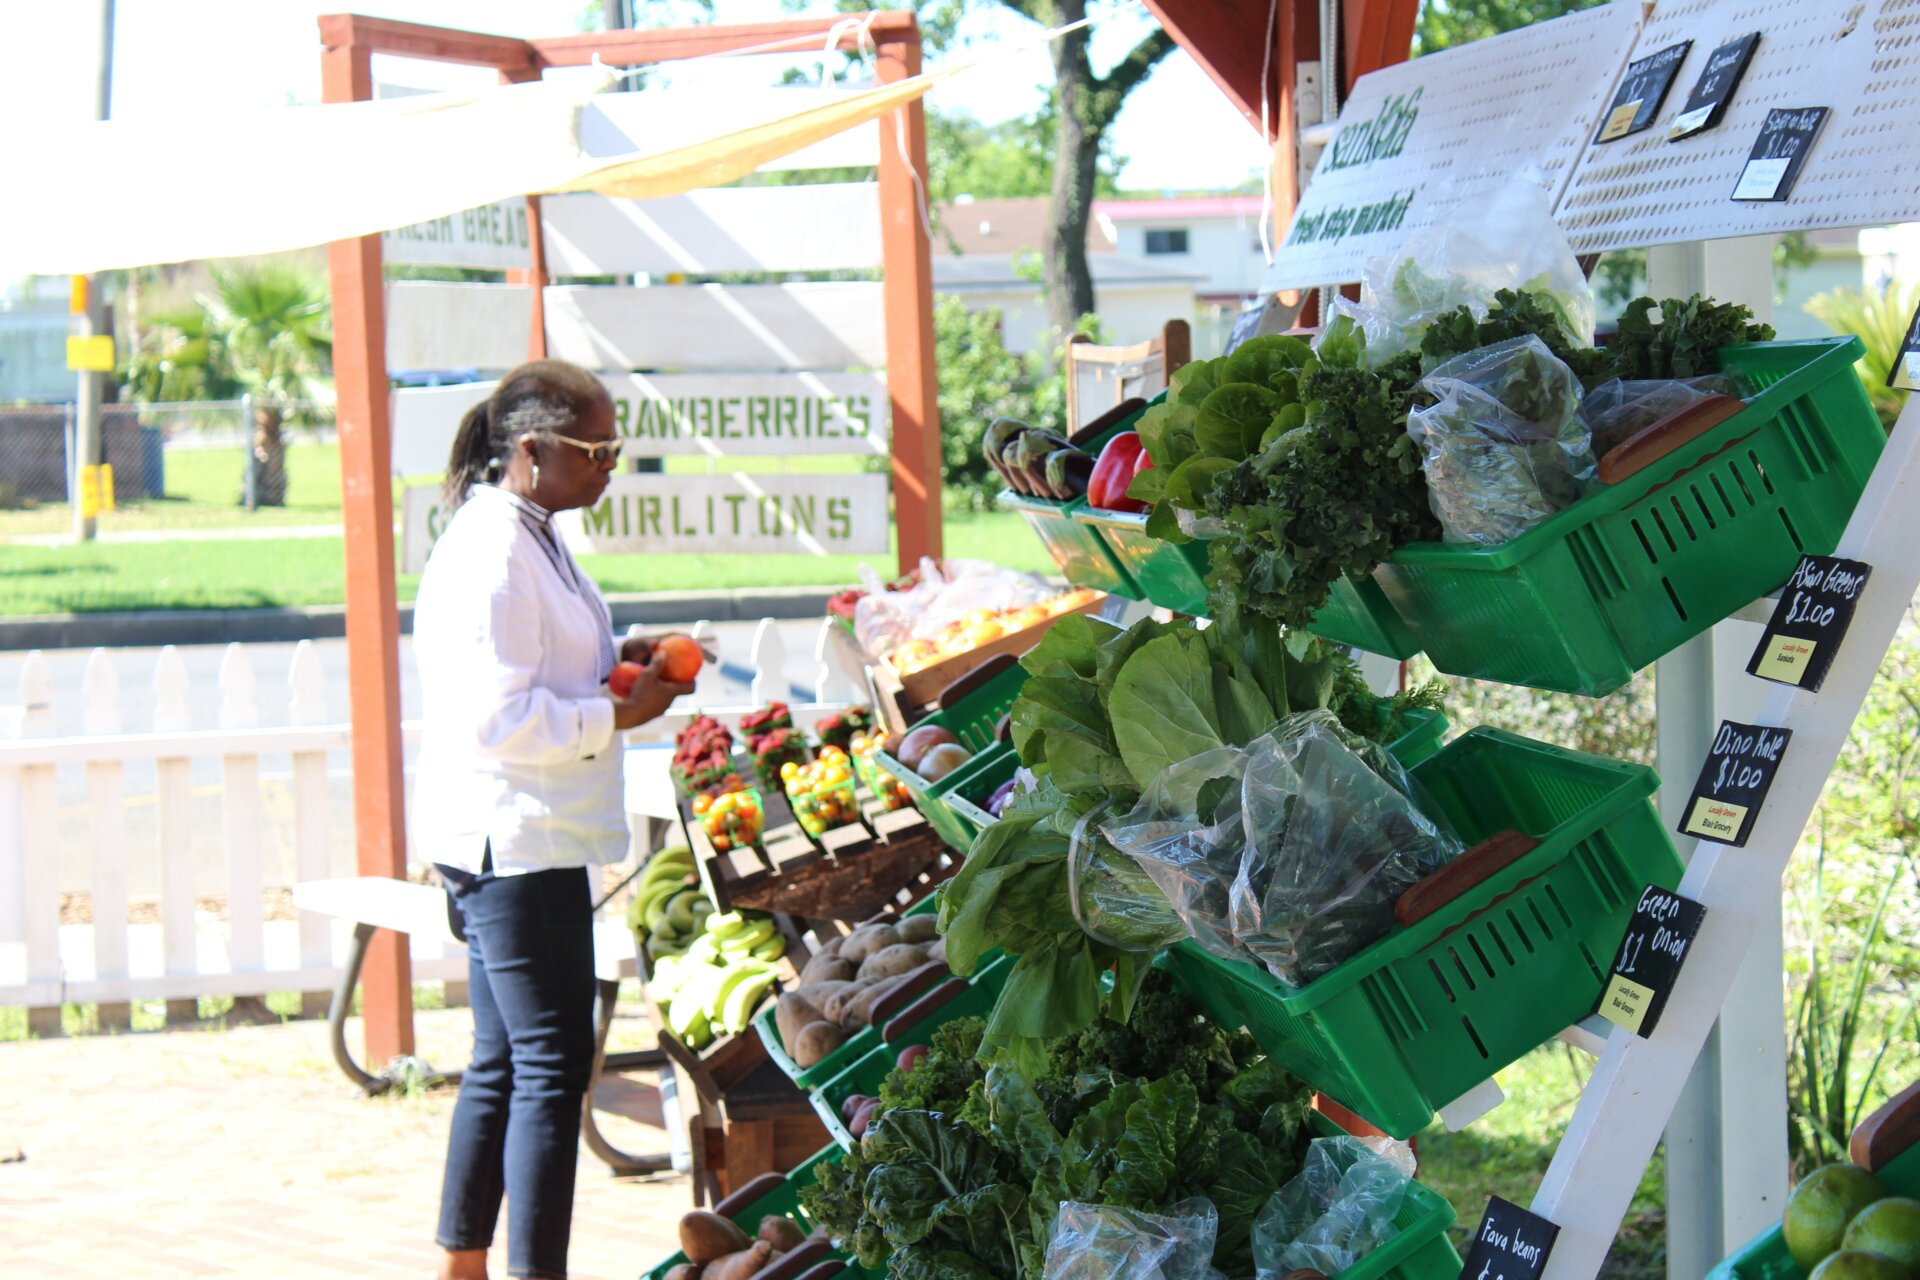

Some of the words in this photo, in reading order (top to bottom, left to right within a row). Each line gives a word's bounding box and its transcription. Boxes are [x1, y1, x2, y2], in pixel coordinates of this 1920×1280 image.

[1322, 85, 1424, 174] sankofa
[1761, 134, 1800, 159] $1.00
[1350, 187, 1415, 237] market
[613, 396, 871, 438] RAWBERRIES
[583, 494, 852, 539] MIRLITONS
[1787, 557, 1824, 589] Asian
[1821, 562, 1865, 600] Greens
[1785, 591, 1835, 627] $1.00
[1713, 724, 1753, 756] Dino
[1752, 728, 1784, 761] Kale
[1713, 755, 1763, 795] $1.00
[1701, 818, 1716, 830] Blair
[1713, 820, 1732, 834] Grocery
[1637, 885, 1680, 923] Green
[1616, 931, 1645, 973] $1
[1612, 997, 1622, 1009] Blair
[1621, 1002, 1635, 1017] Grocery
[1481, 1217, 1509, 1251] Fava
[1512, 1227, 1541, 1269] beans
